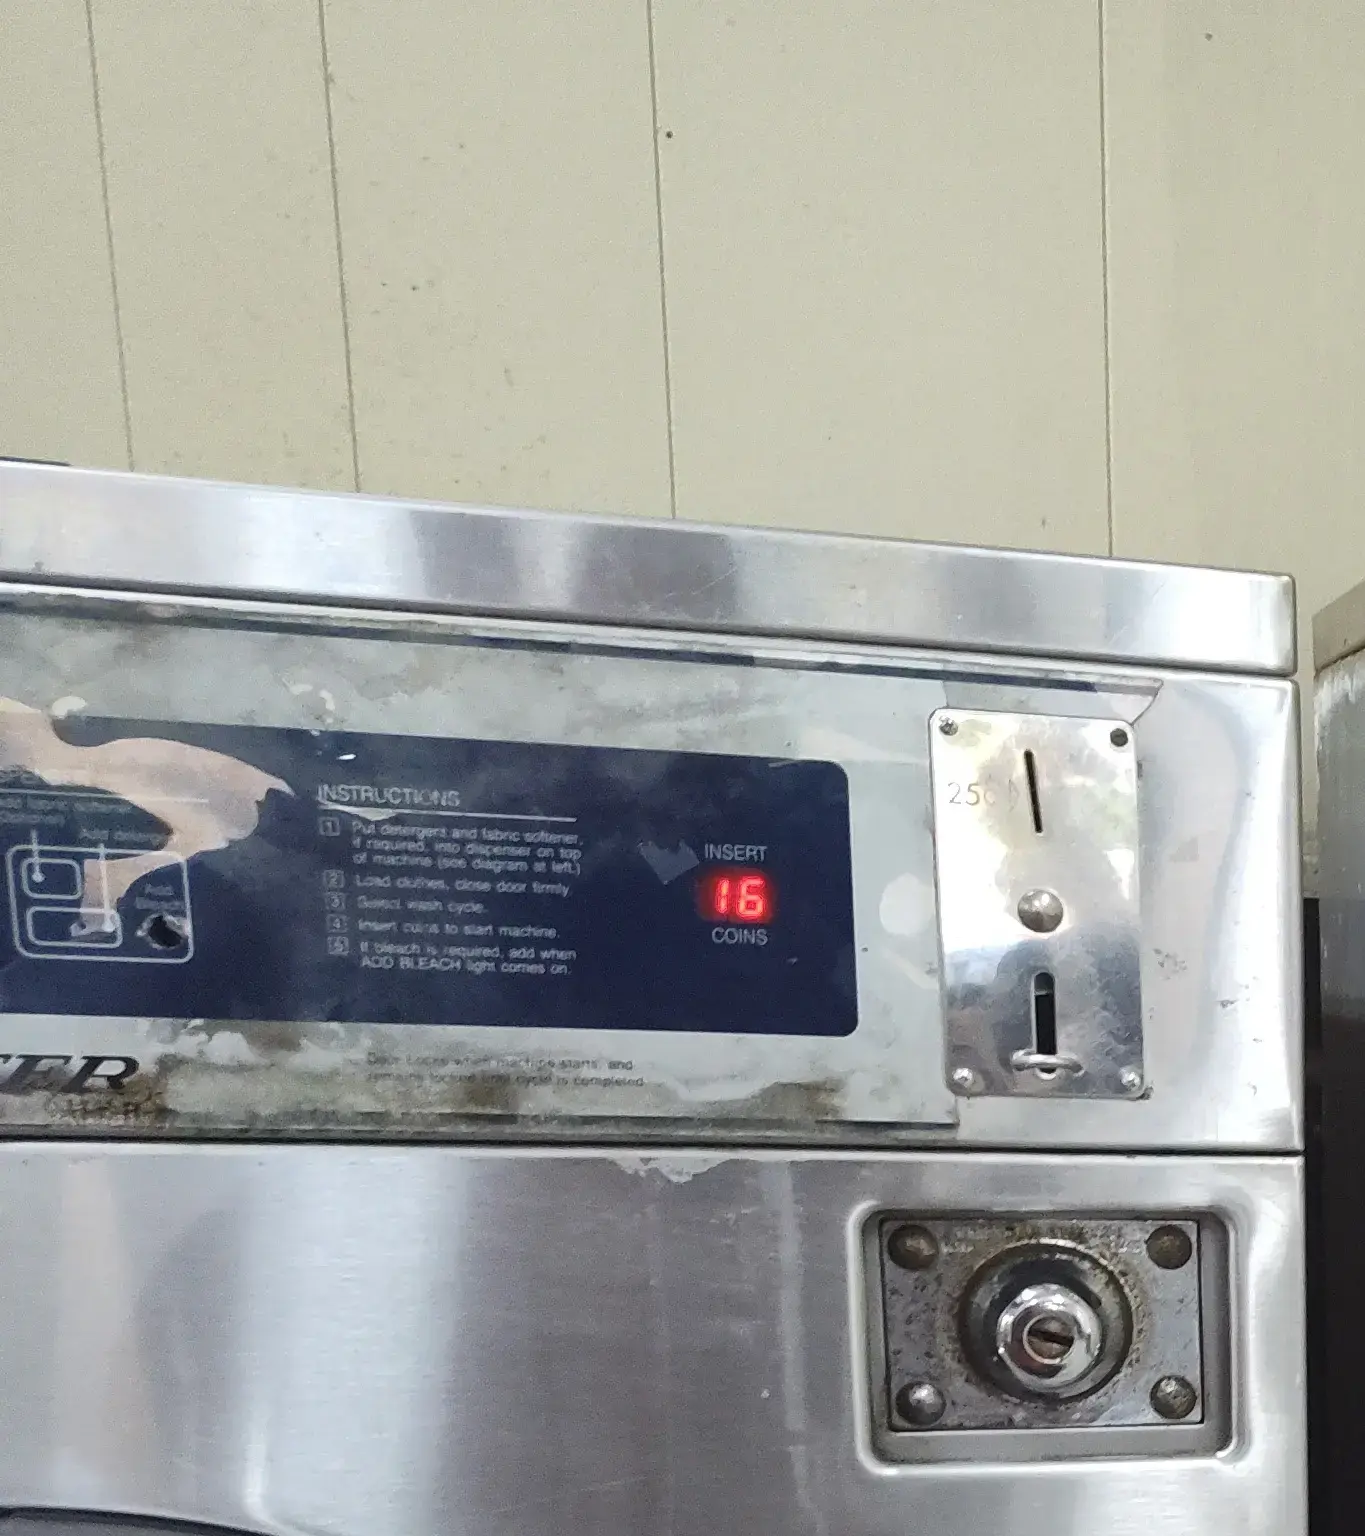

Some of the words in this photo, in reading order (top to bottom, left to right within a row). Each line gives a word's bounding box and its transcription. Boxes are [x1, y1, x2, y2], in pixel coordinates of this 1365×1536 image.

[317, 784, 460, 807] INSTRUCTIONS
[452, 828, 477, 839] and
[536, 847, 555, 857] on
[704, 842, 768, 863] INSERT
[496, 881, 527, 893] door
[715, 874, 768, 921] 16
[711, 926, 769, 946] COINS
[361, 956, 394, 969] ADD
[399, 956, 461, 971] BLEACH
